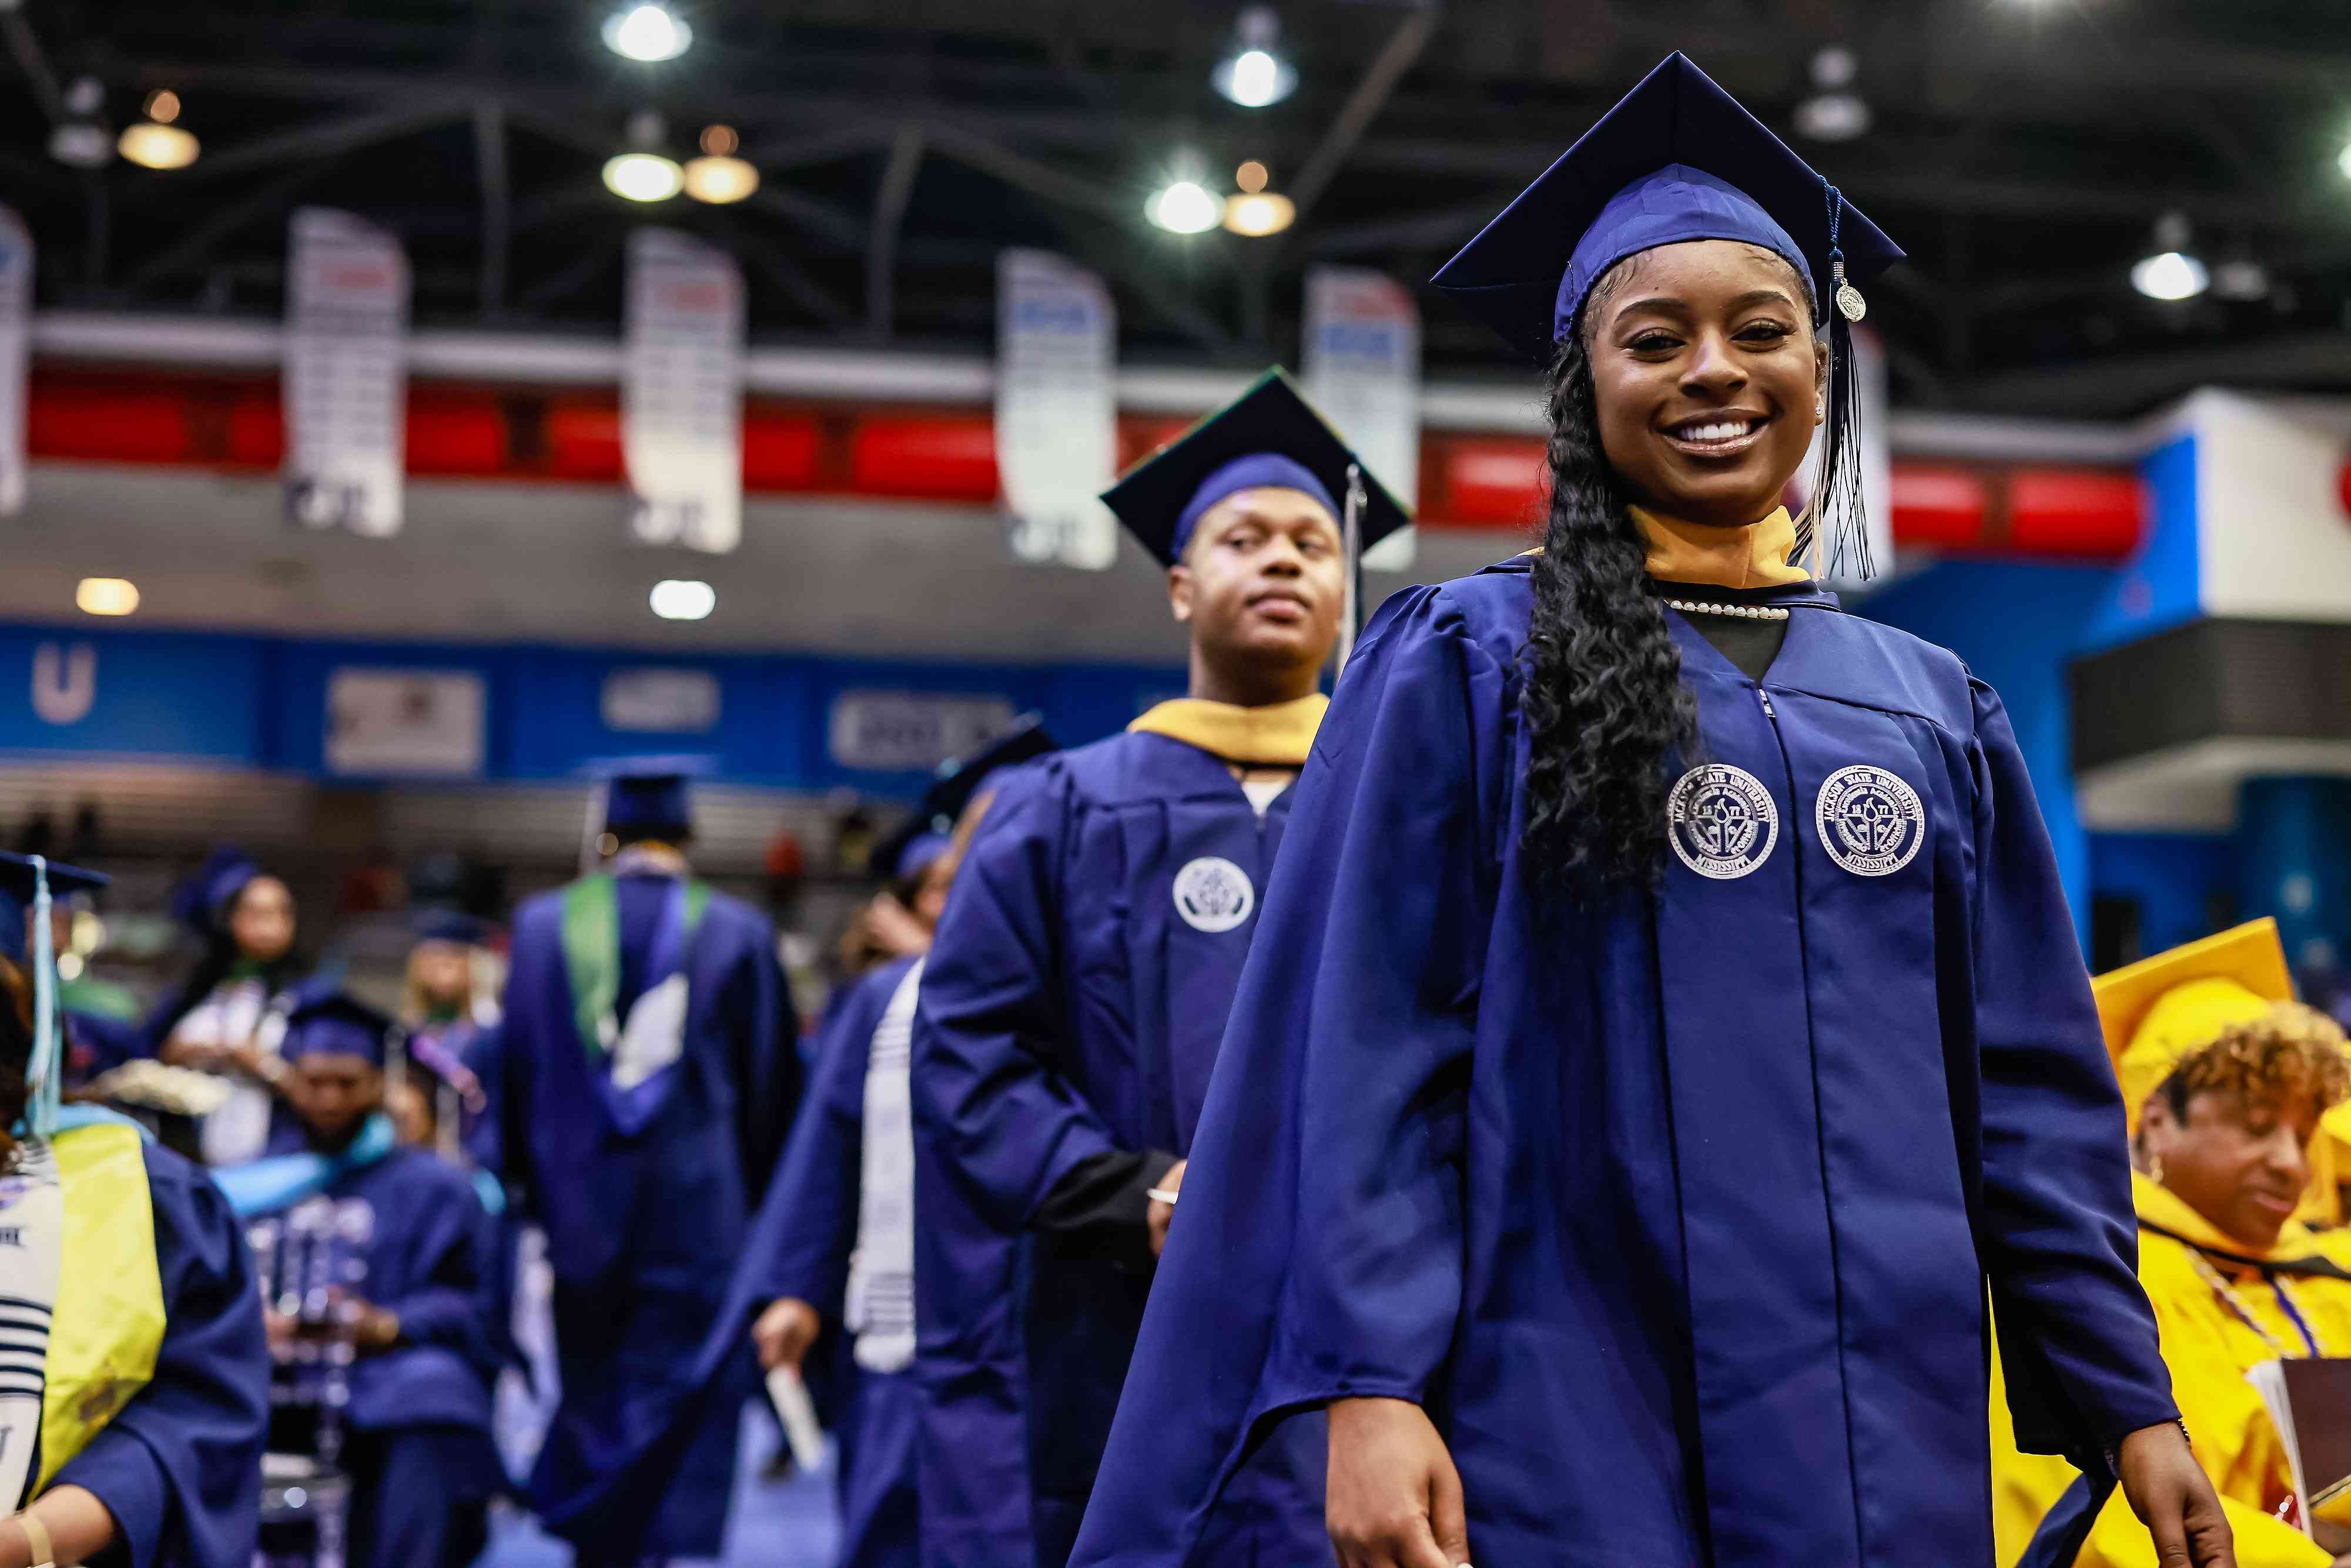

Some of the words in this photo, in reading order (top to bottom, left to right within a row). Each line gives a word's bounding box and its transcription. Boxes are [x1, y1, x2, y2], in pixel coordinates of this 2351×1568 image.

[1730, 775, 1770, 822] UNIVERSITY
[1824, 781, 1846, 822] JACKSON
[1843, 773, 1873, 785] STATE
[1876, 775, 1917, 821] UNIVERSITY
